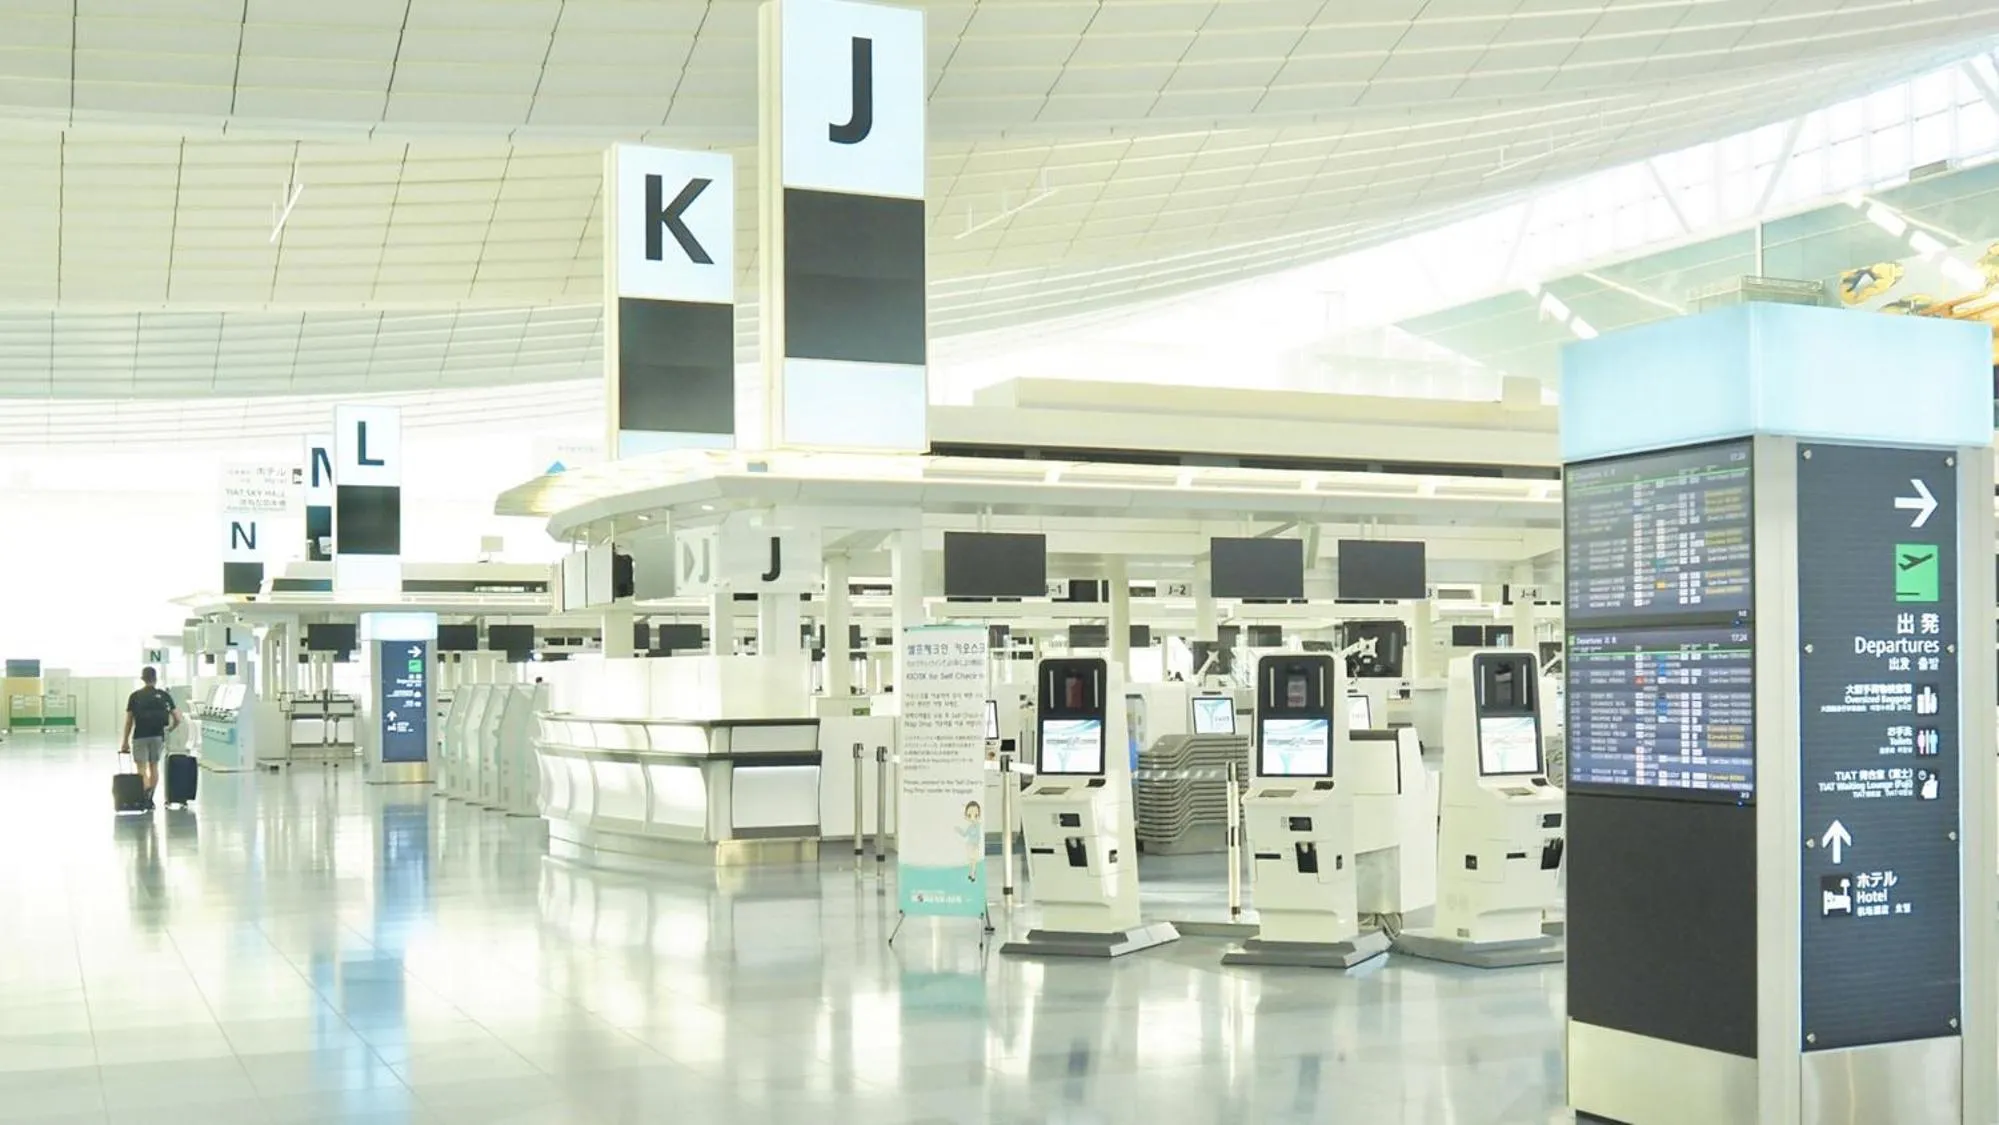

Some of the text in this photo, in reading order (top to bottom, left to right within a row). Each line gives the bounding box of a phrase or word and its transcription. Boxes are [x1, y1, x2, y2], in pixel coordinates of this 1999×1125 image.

[829, 36, 873, 144] J
[645, 174, 714, 264] K
[357, 421, 384, 466] L
[232, 522, 256, 549] N
[762, 536, 782, 582] J
[1168, 583, 1186, 595] J-2
[226, 627, 238, 646] L
[150, 650, 161, 662] N
[1854, 636, 1940, 658] Departures
[1834, 770, 1858, 781] TIAT
[1856, 870, 1898, 889] ホテル
[1856, 888, 1888, 904] Hotel
